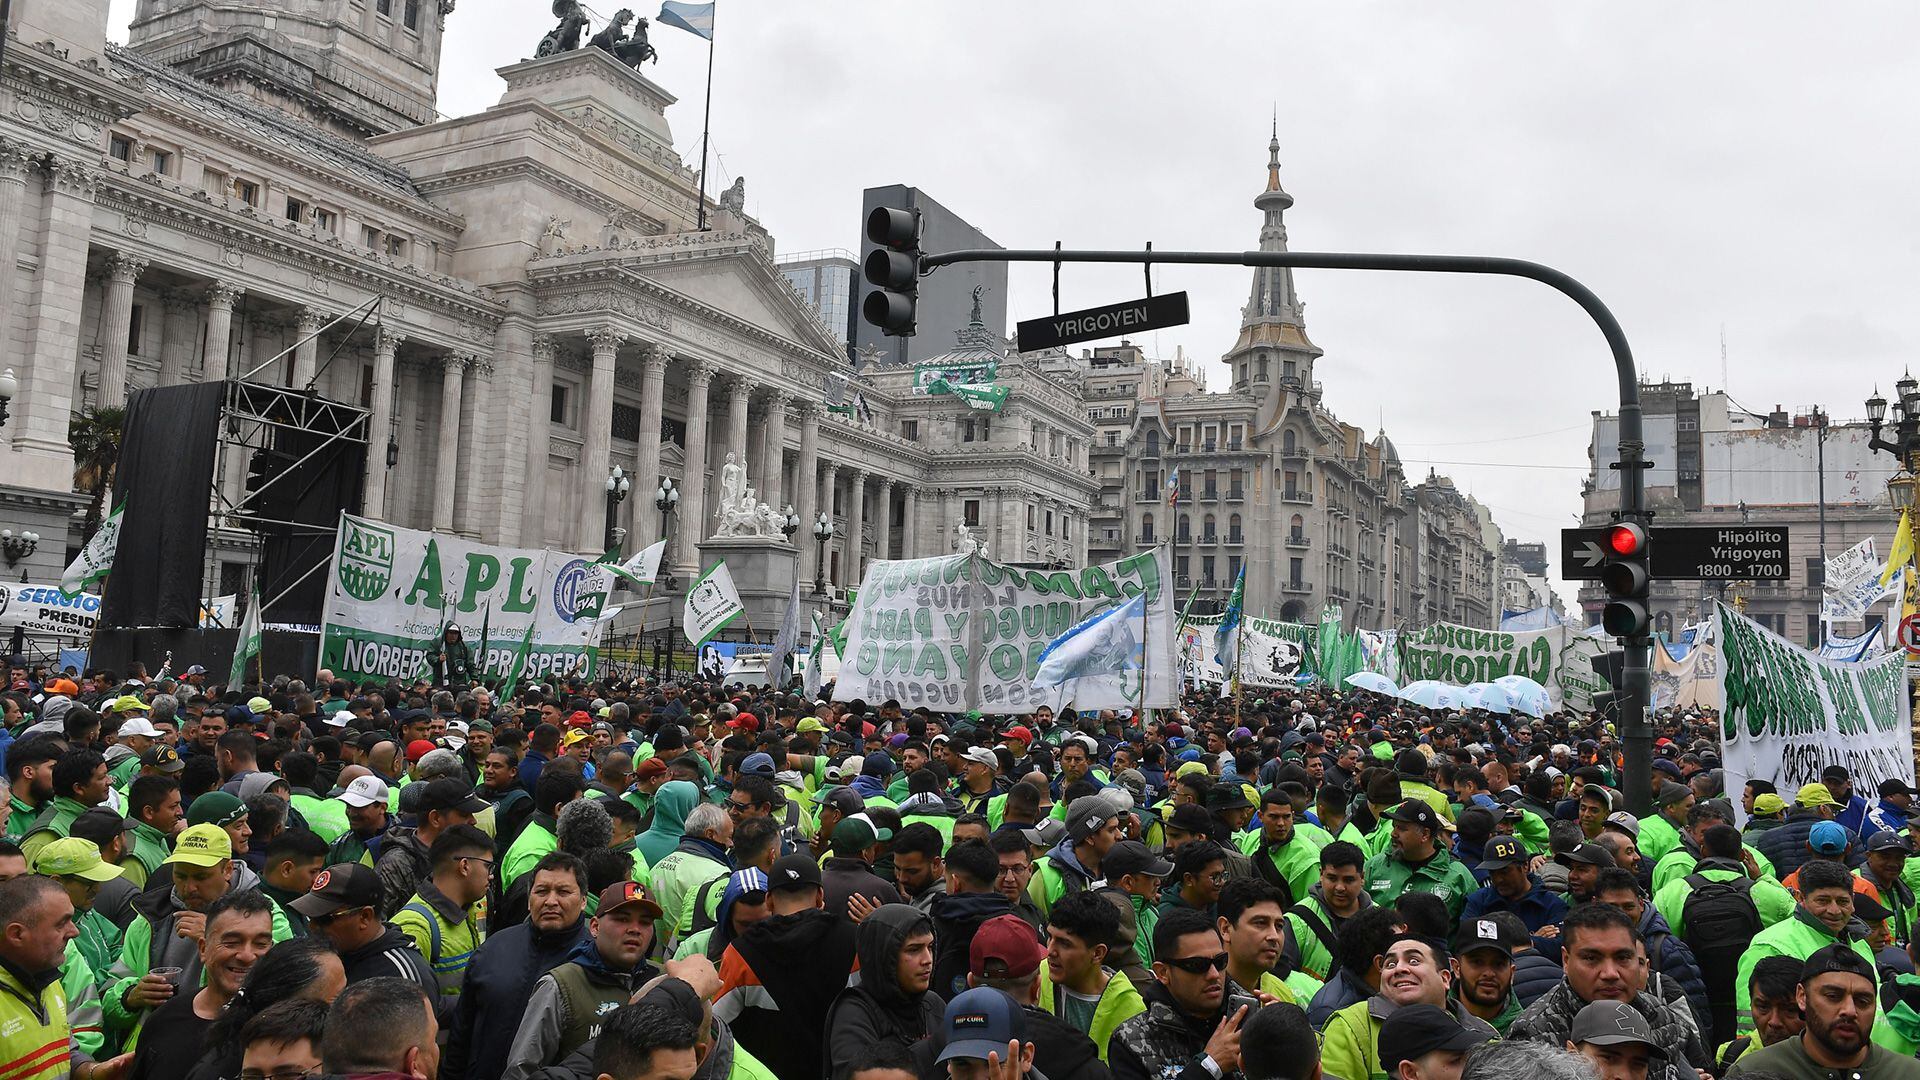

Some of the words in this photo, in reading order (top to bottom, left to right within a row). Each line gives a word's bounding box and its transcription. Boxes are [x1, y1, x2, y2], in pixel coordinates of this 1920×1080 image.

[1053, 306, 1149, 338] YRIGOYEN
[346, 527, 390, 562] APL
[1718, 530, 1781, 546] Hipólito
[1710, 546, 1781, 562] Yrigoyen
[405, 538, 537, 614] APL
[1697, 564, 1732, 576] 1800
[1747, 564, 1782, 576] 1700
[21, 620, 80, 635] ASOCIACION
[342, 638, 428, 680] NORBER
